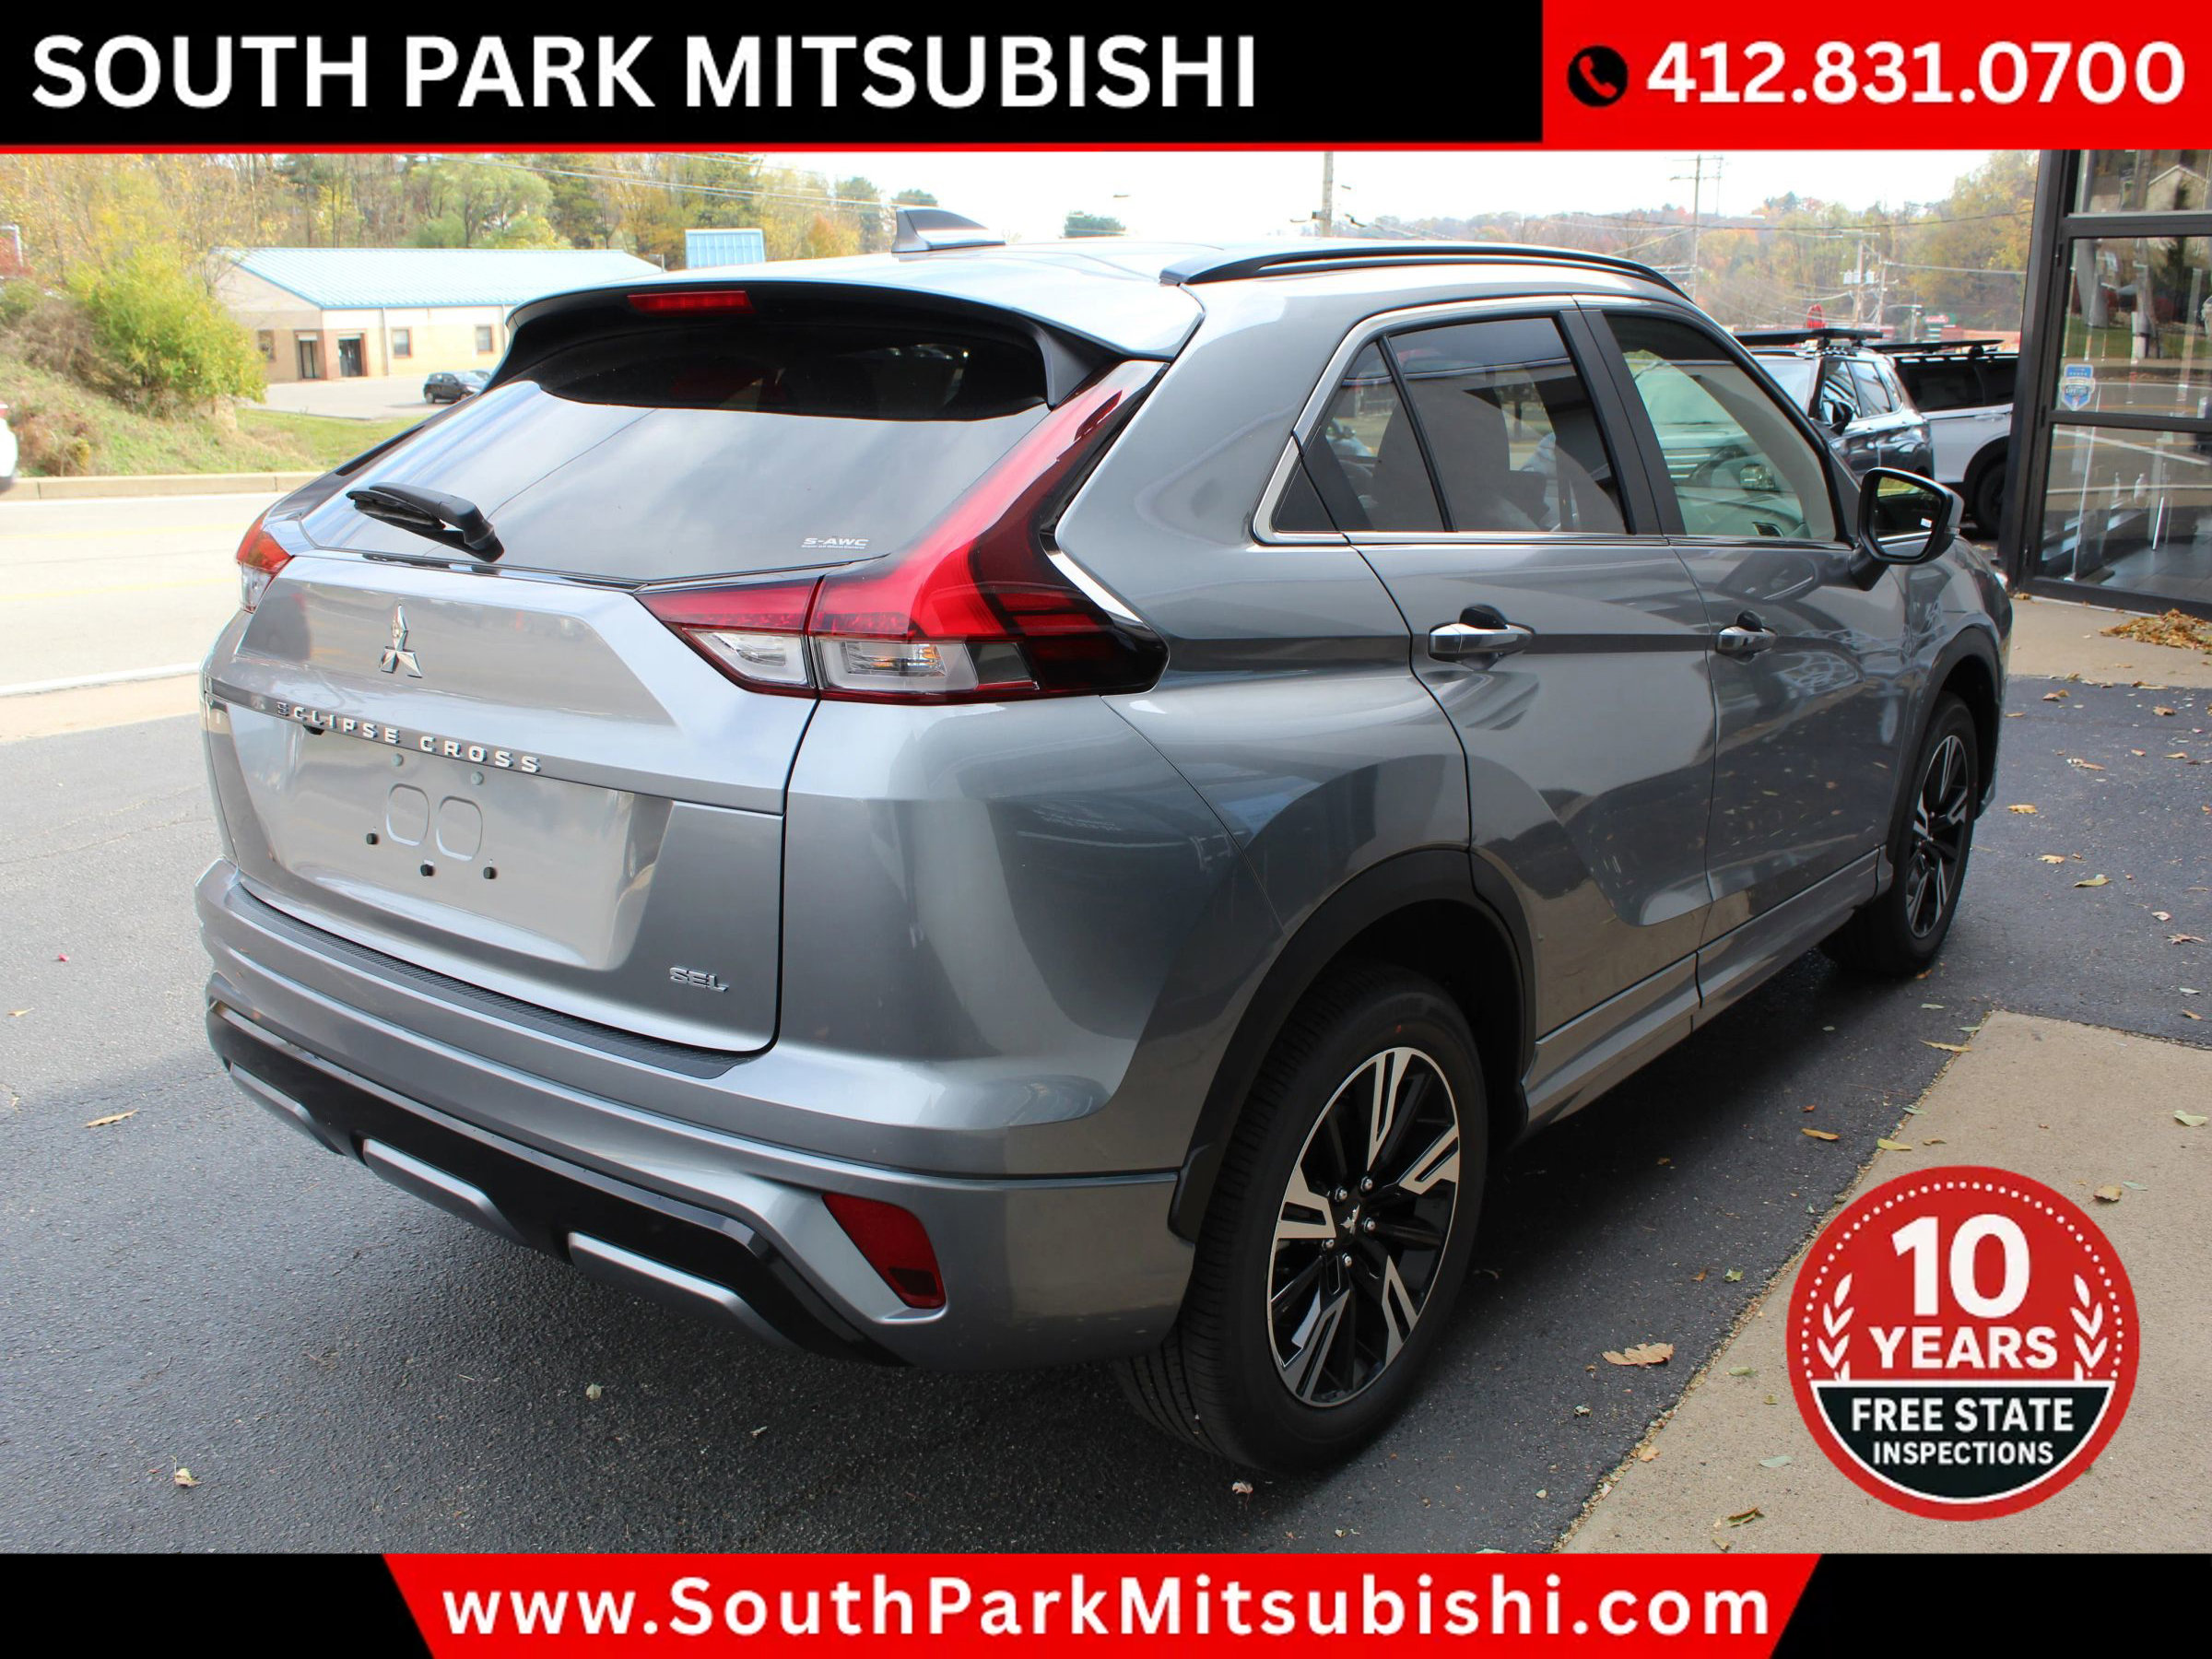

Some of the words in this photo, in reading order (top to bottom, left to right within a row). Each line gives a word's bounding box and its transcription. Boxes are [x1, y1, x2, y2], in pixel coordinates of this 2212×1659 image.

[803, 537, 870, 546] S-AWC
[276, 702, 401, 744] ECLIPSE
[419, 735, 541, 773] CROSS
[669, 967, 729, 993] SEL
